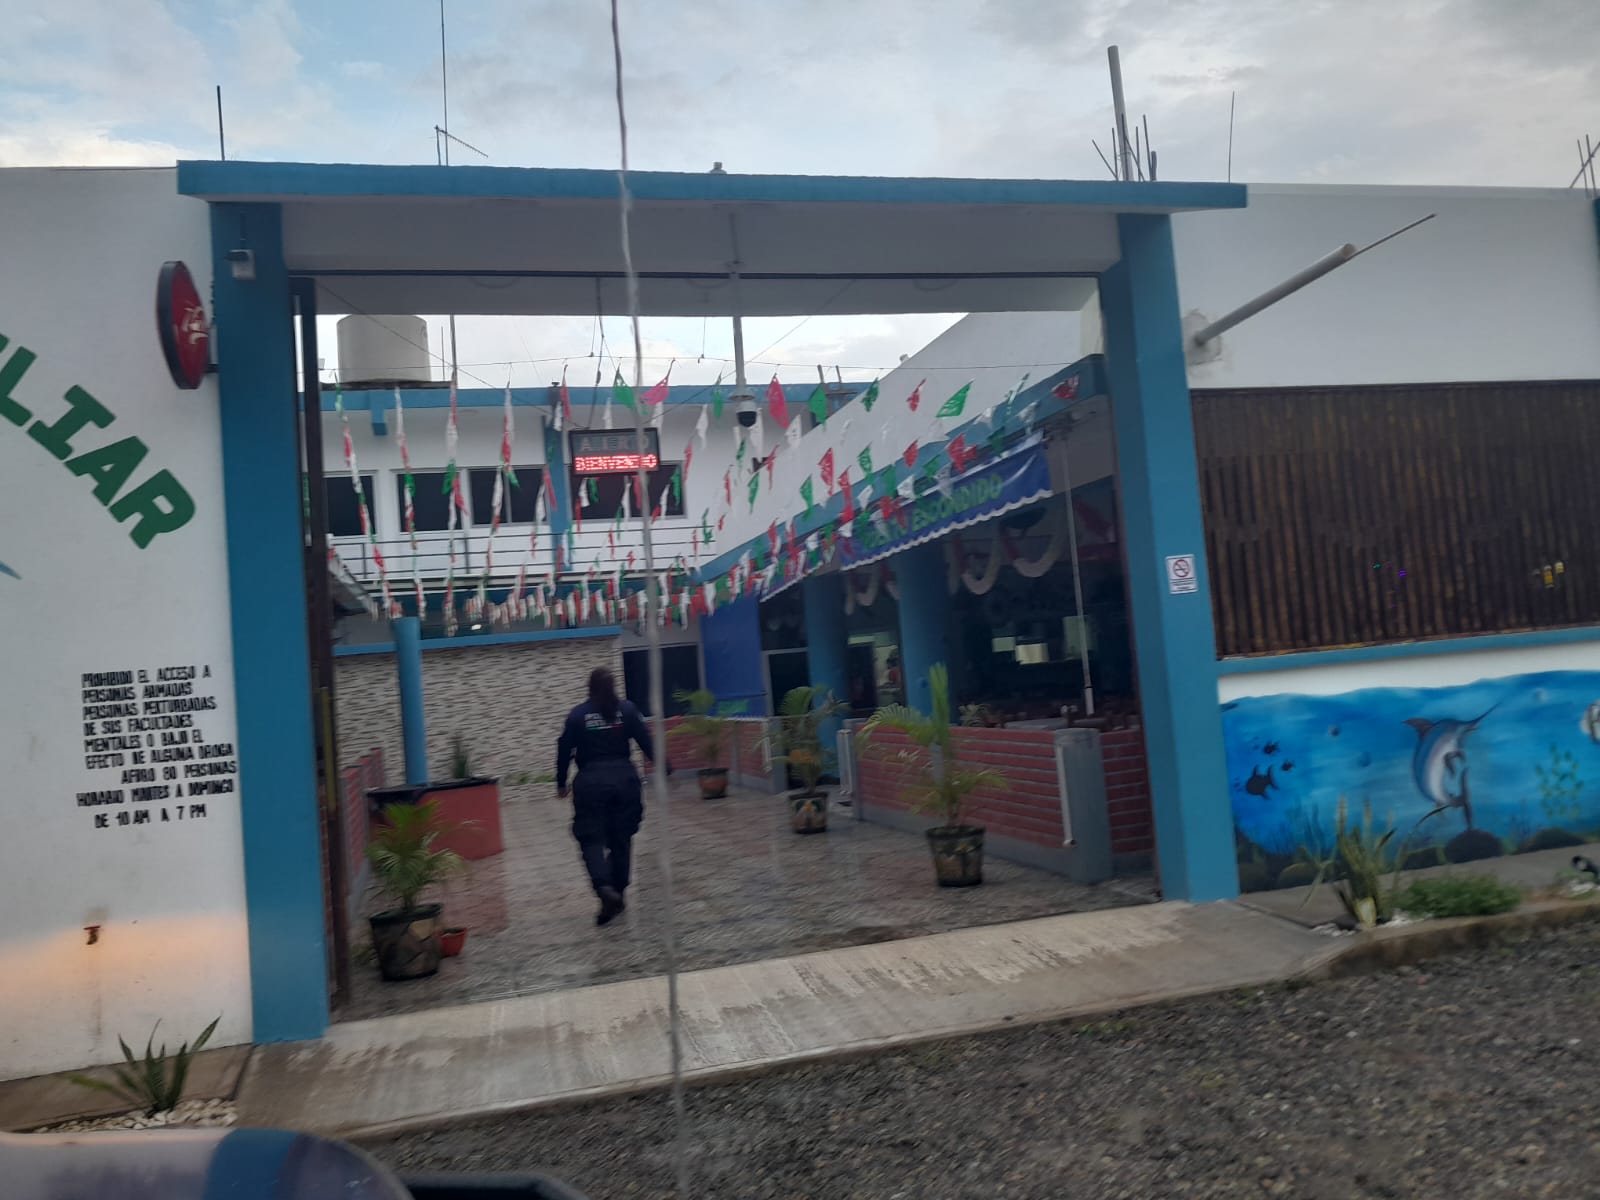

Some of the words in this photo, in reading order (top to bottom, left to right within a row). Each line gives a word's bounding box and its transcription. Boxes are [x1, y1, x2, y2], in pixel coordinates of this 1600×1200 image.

[0, 333, 196, 549] LIAR
[575, 453, 657, 471] BIENVENIO
[81, 670, 133, 688] PROHIBIDO
[138, 670, 150, 683] EL
[157, 666, 195, 681] ACCESO
[202, 665, 211, 678] A
[82, 687, 136, 703] PERSONAS
[142, 682, 193, 698] ARMADAS
[82, 703, 138, 720] PERSONAS
[143, 696, 217, 715] PERTURBADAS
[83, 722, 96, 736] DE
[101, 720, 121, 734] SUS
[127, 714, 194, 732] FACULTADES
[84, 734, 142, 752] MENTALES
[147, 733, 155, 747] O
[161, 730, 188, 746] BAJO
[192, 729, 203, 743] EL
[85, 753, 124, 769] EFECTO
[132, 751, 146, 764] DE
[151, 747, 195, 763] ALGUNA
[198, 743, 234, 759] DROGA
[184, 761, 237, 778] PERSONAS
[76, 790, 124, 807] HORARIO
[131, 785, 169, 802] MARTES
[175, 784, 182, 798] A
[188, 779, 234, 796] DOMINGO
[94, 813, 109, 828] DE
[132, 810, 150, 824] AM
[161, 808, 170, 822] A
[176, 806, 185, 820] 7
[190, 804, 207, 818] PM
